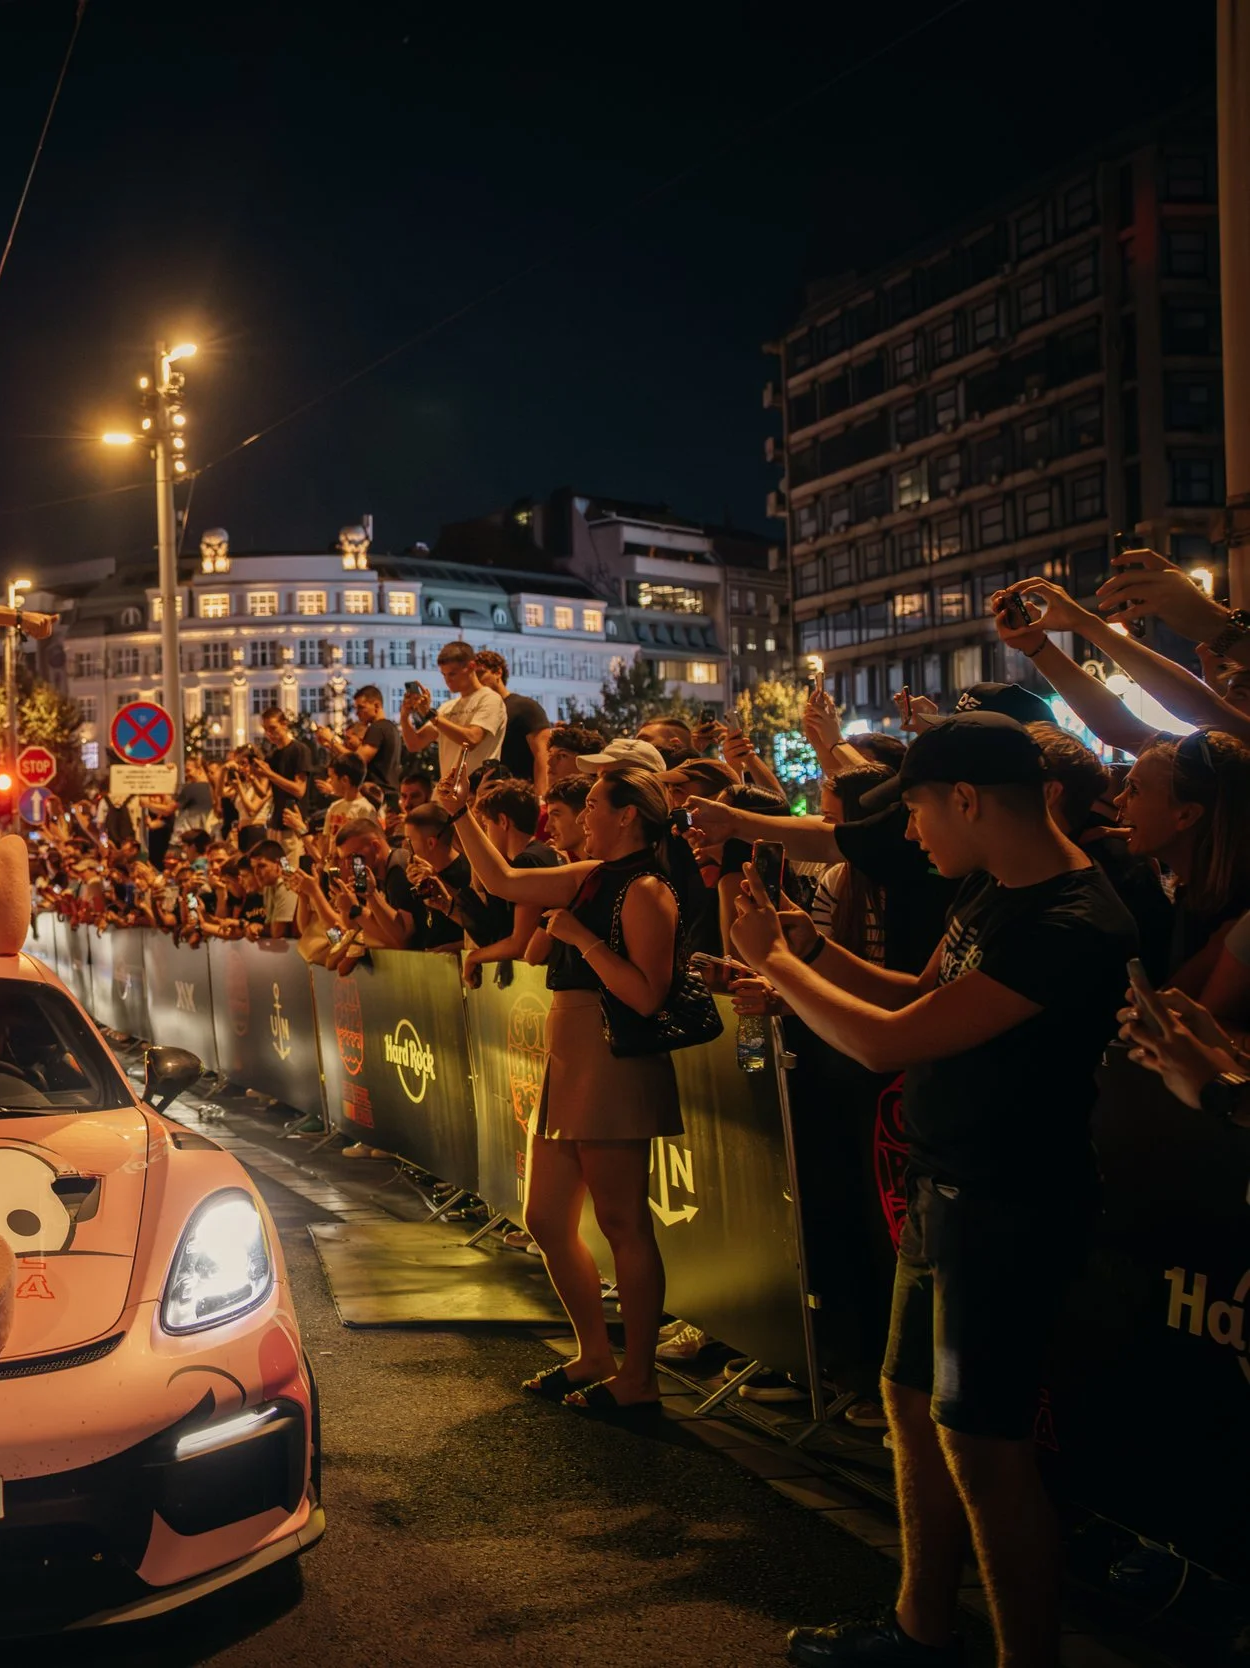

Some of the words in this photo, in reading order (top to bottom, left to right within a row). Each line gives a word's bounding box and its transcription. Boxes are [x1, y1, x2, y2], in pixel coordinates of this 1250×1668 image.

[22, 760, 51, 774] STOP
[384, 1033, 409, 1067] Hard
[409, 1039, 436, 1081] Rock
[1164, 1266, 1246, 1351] Ha
